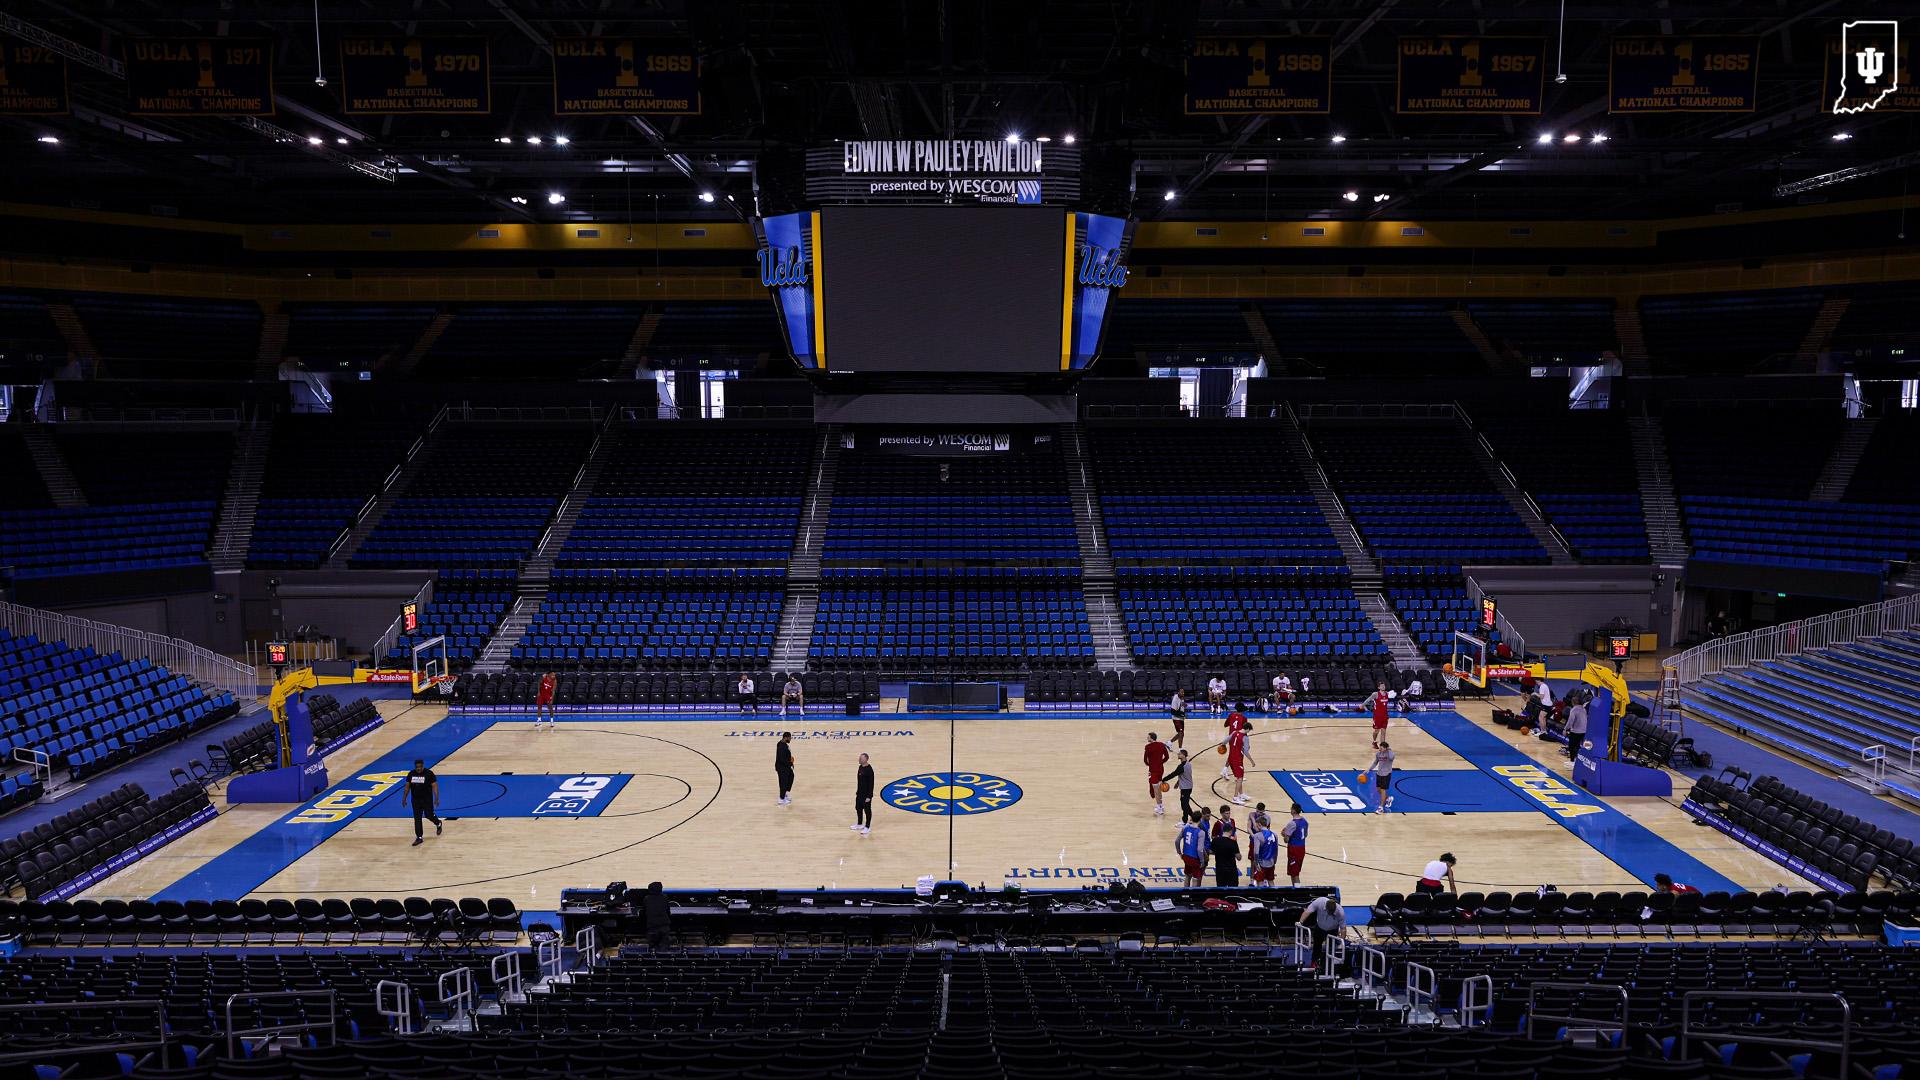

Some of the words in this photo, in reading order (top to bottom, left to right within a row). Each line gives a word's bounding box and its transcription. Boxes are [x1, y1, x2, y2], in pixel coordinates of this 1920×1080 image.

[135, 42, 192, 61] UCLA
[344, 39, 396, 56] UCLA
[556, 41, 607, 57] UCLA
[1403, 39, 1453, 56] UCLA
[1615, 40, 1666, 56] UCLA
[14, 46, 56, 65] 1972
[226, 47, 262, 65] 1971
[433, 54, 481, 72] 1970
[1277, 54, 1324, 72] 1968
[1703, 53, 1751, 71] 1965
[646, 55, 693, 72] 1969
[1491, 55, 1537, 72] 1967
[168, 88, 235, 97] BASKETBALL
[386, 88, 444, 97] BASKETBALL
[597, 89, 655, 97] BASKETBALL
[1228, 89, 1286, 97] BASKETBALL
[1441, 89, 1498, 97] BASKETBALL
[1653, 87, 1711, 95] BASKETBALL
[139, 97, 194, 110] NATIONAL
[201, 98, 262, 110] CHAMPIONS
[353, 98, 411, 109] NATIONAL
[413, 98, 478, 108] CHAMPIONS
[564, 99, 622, 110] NATIONAL
[623, 99, 689, 110] CHAMPIONS
[1195, 99, 1253, 109] NATIONAL
[1254, 98, 1319, 108] CHAMPIONS
[1407, 98, 1464, 109] NATIONAL
[1466, 98, 1531, 109] CHAMPIONS
[1618, 97, 1677, 108] NATIONAL
[1679, 96, 1744, 107] CHAMPIONS
[844, 140, 894, 173] EDWIN
[896, 141, 912, 172] W
[915, 140, 972, 172] PAULEY
[975, 140, 1042, 173] PAVILION
[870, 180, 926, 194] presented
[930, 180, 945, 193] by
[949, 179, 1016, 194] WESCOM
[980, 194, 1016, 203] Financial
[757, 246, 809, 287] Ucla
[1079, 245, 1128, 288] Ucla
[879, 436, 921, 446] presented
[923, 435, 935, 446] by
[938, 433, 991, 445] WESCOM
[405, 613, 416, 631] 30
[1483, 608, 1494, 626] 30
[272, 652, 285, 662] 30
[1614, 646, 1627, 656] 30
[285, 770, 412, 824] UCLA
[1491, 764, 1606, 818] UCLA
[1301, 828, 1305, 840] 1
[1004, 867, 1121, 878] COURT
